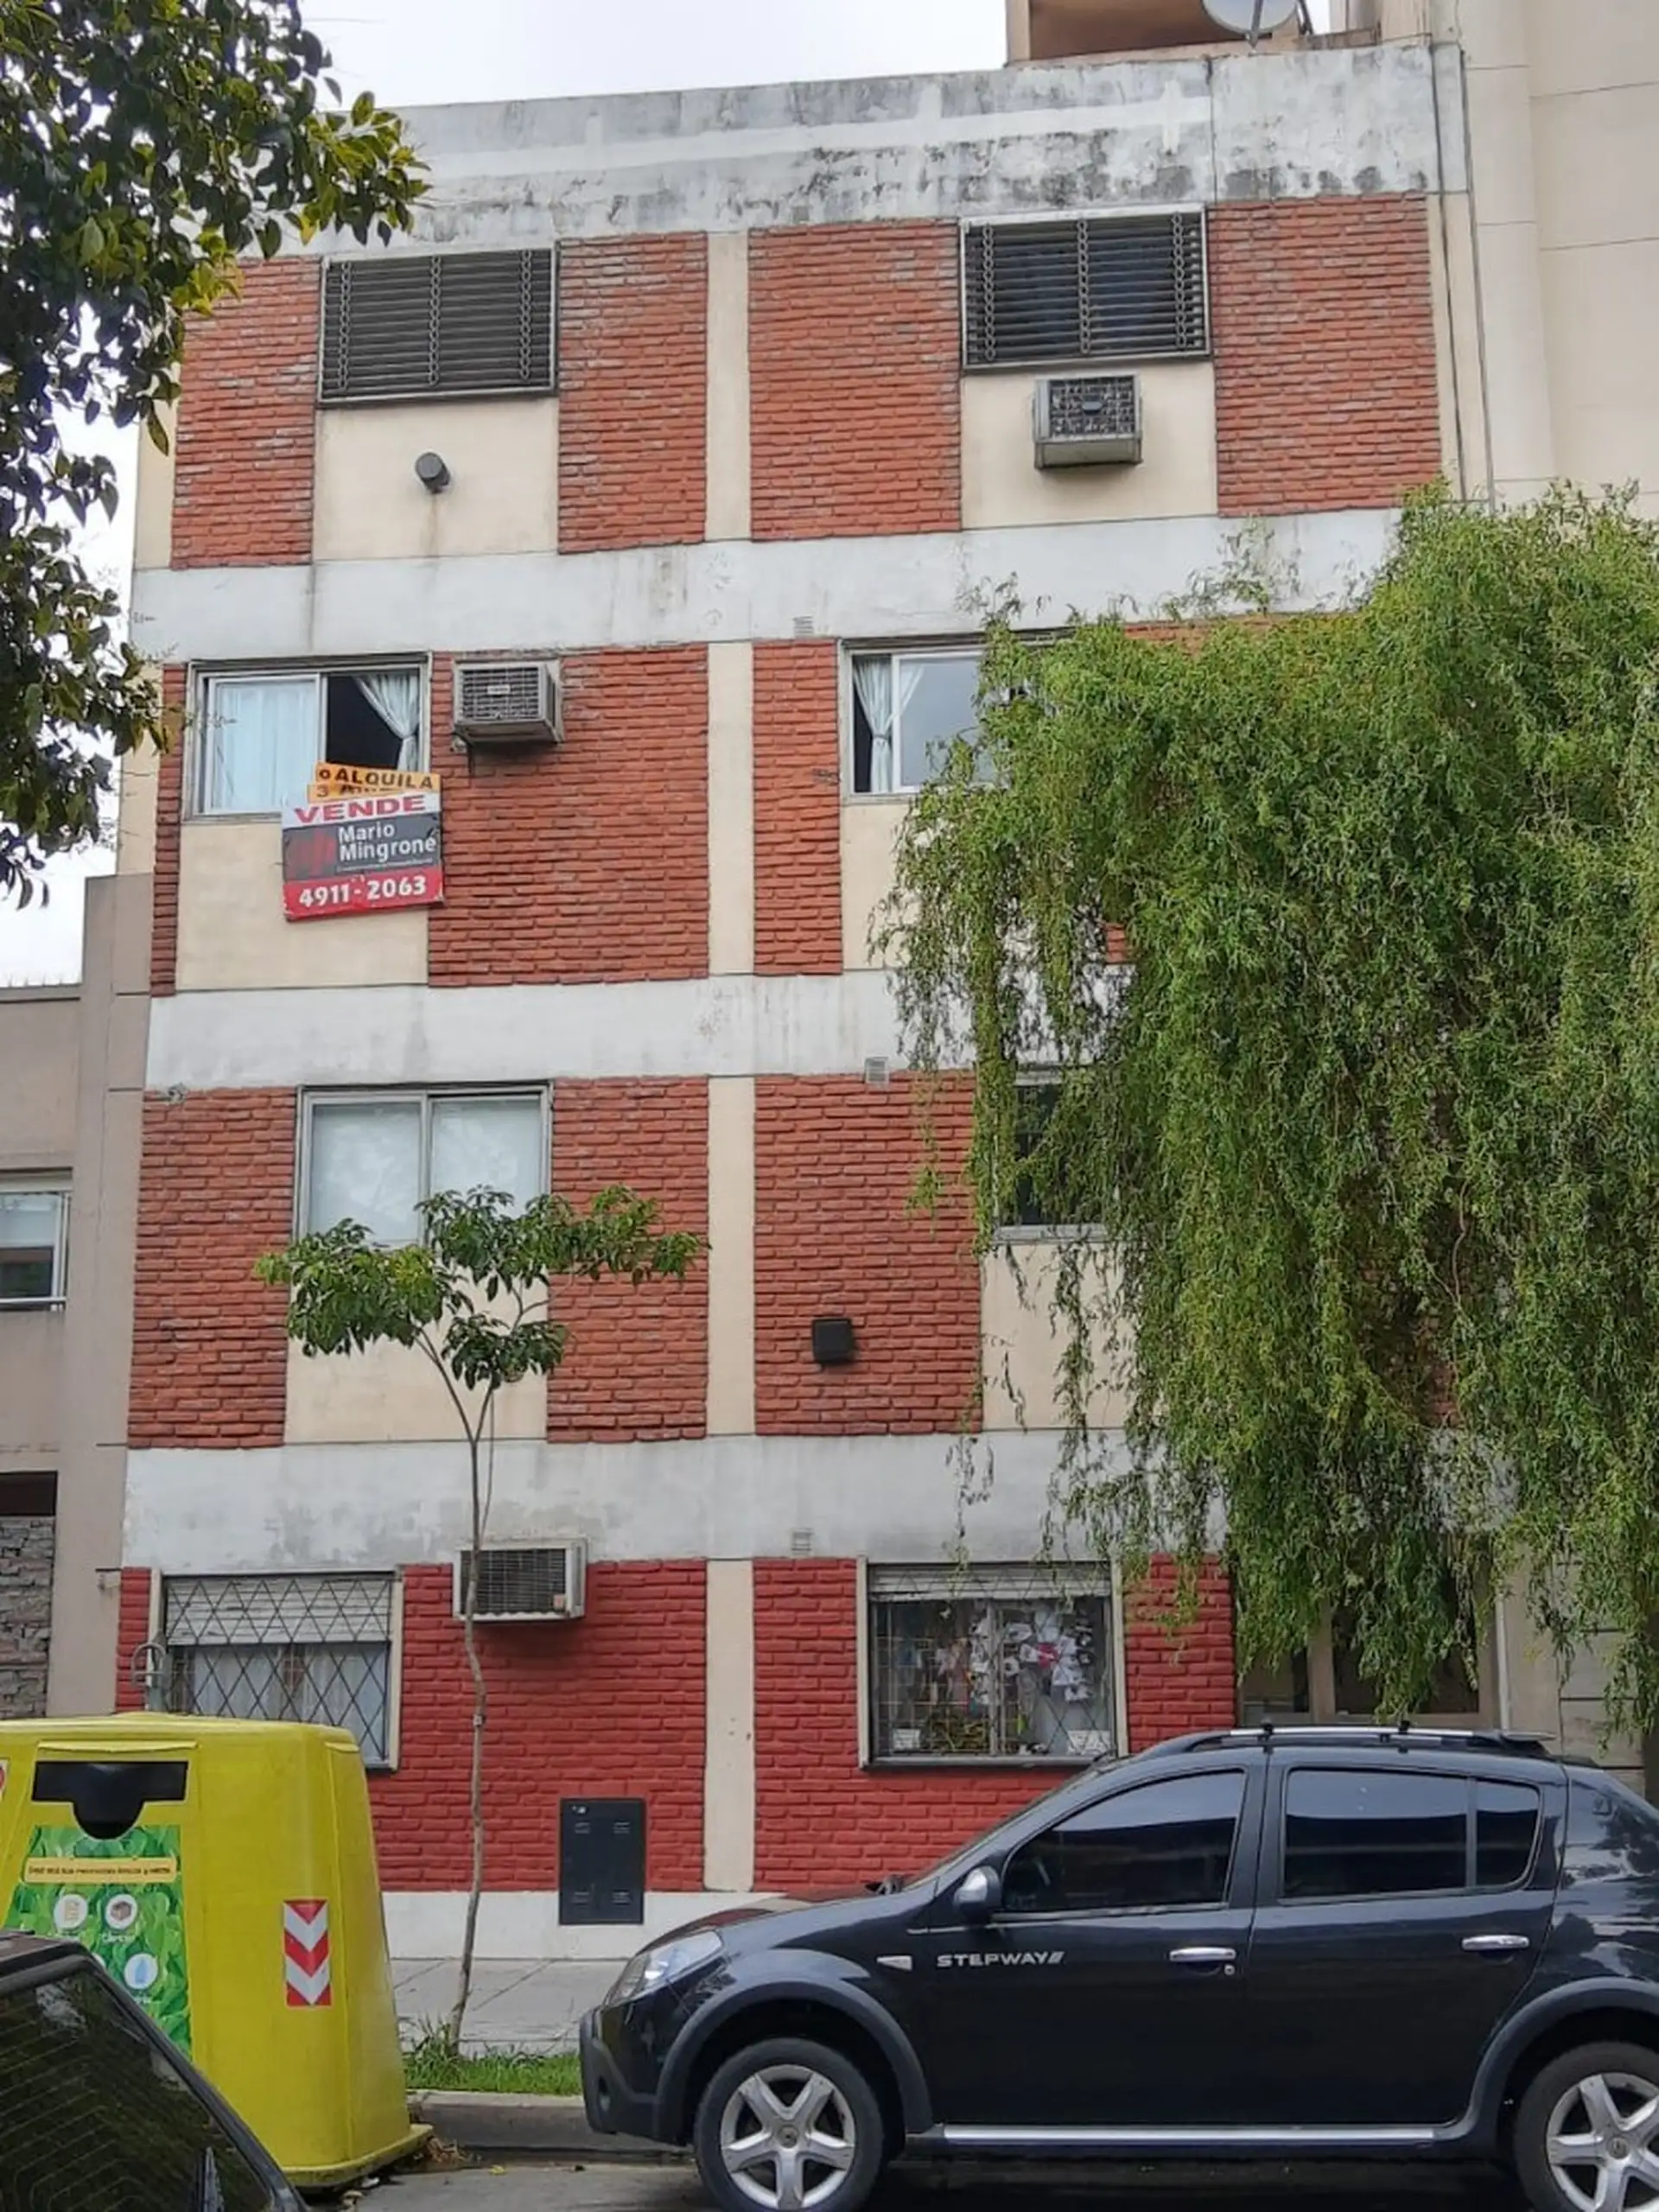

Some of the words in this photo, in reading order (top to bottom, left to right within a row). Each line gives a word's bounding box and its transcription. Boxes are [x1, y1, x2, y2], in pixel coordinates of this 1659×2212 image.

[334, 768, 434, 790] ALQUILA
[317, 786, 328, 798] 3
[294, 794, 427, 824] VENDE
[338, 821, 395, 843] Mario
[937, 1952, 1048, 1967] STEPWAY
